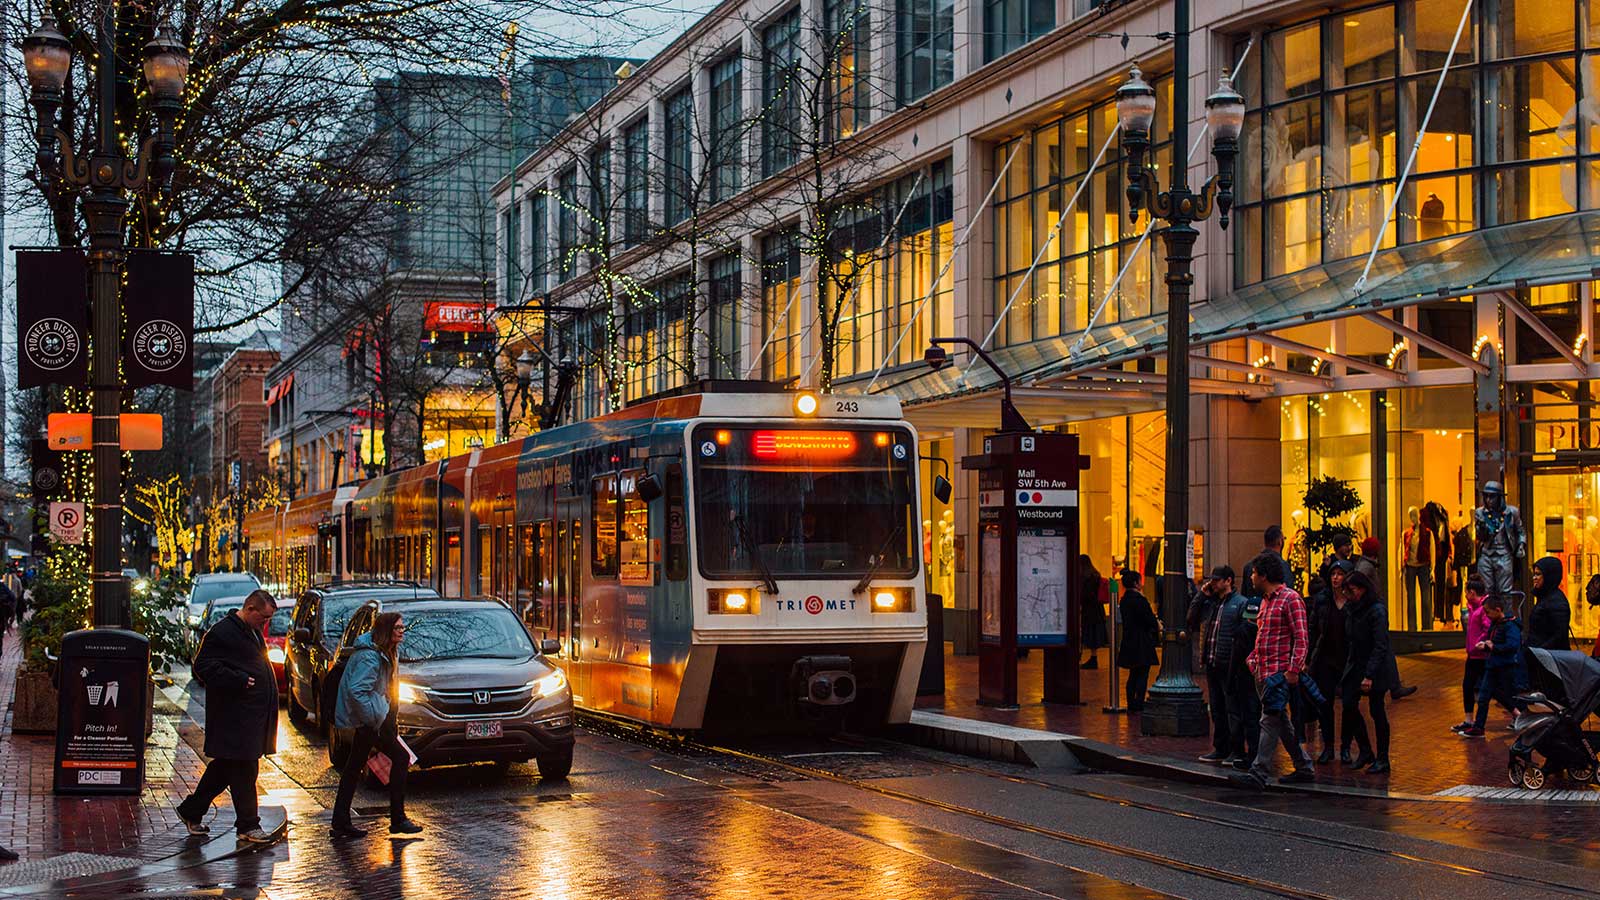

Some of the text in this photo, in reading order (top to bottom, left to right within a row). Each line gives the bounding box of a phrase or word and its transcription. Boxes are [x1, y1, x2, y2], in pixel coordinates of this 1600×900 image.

[28, 321, 76, 352] PIONEER DISTRICT
[137, 323, 183, 355] PIONEER DISTRICT
[836, 401, 859, 413] 243
[517, 466, 541, 490] nonstop
[542, 463, 554, 486] low
[555, 460, 572, 484] fares
[1018, 469, 1035, 478] Mall
[1018, 479, 1067, 488] SW 5th Ave
[1018, 509, 1063, 519] Westbound
[776, 600, 856, 611] TRI MET
[85, 723, 118, 732] Pitch In!
[468, 724, 482, 735] 290
[79, 772, 99, 780] PDC
